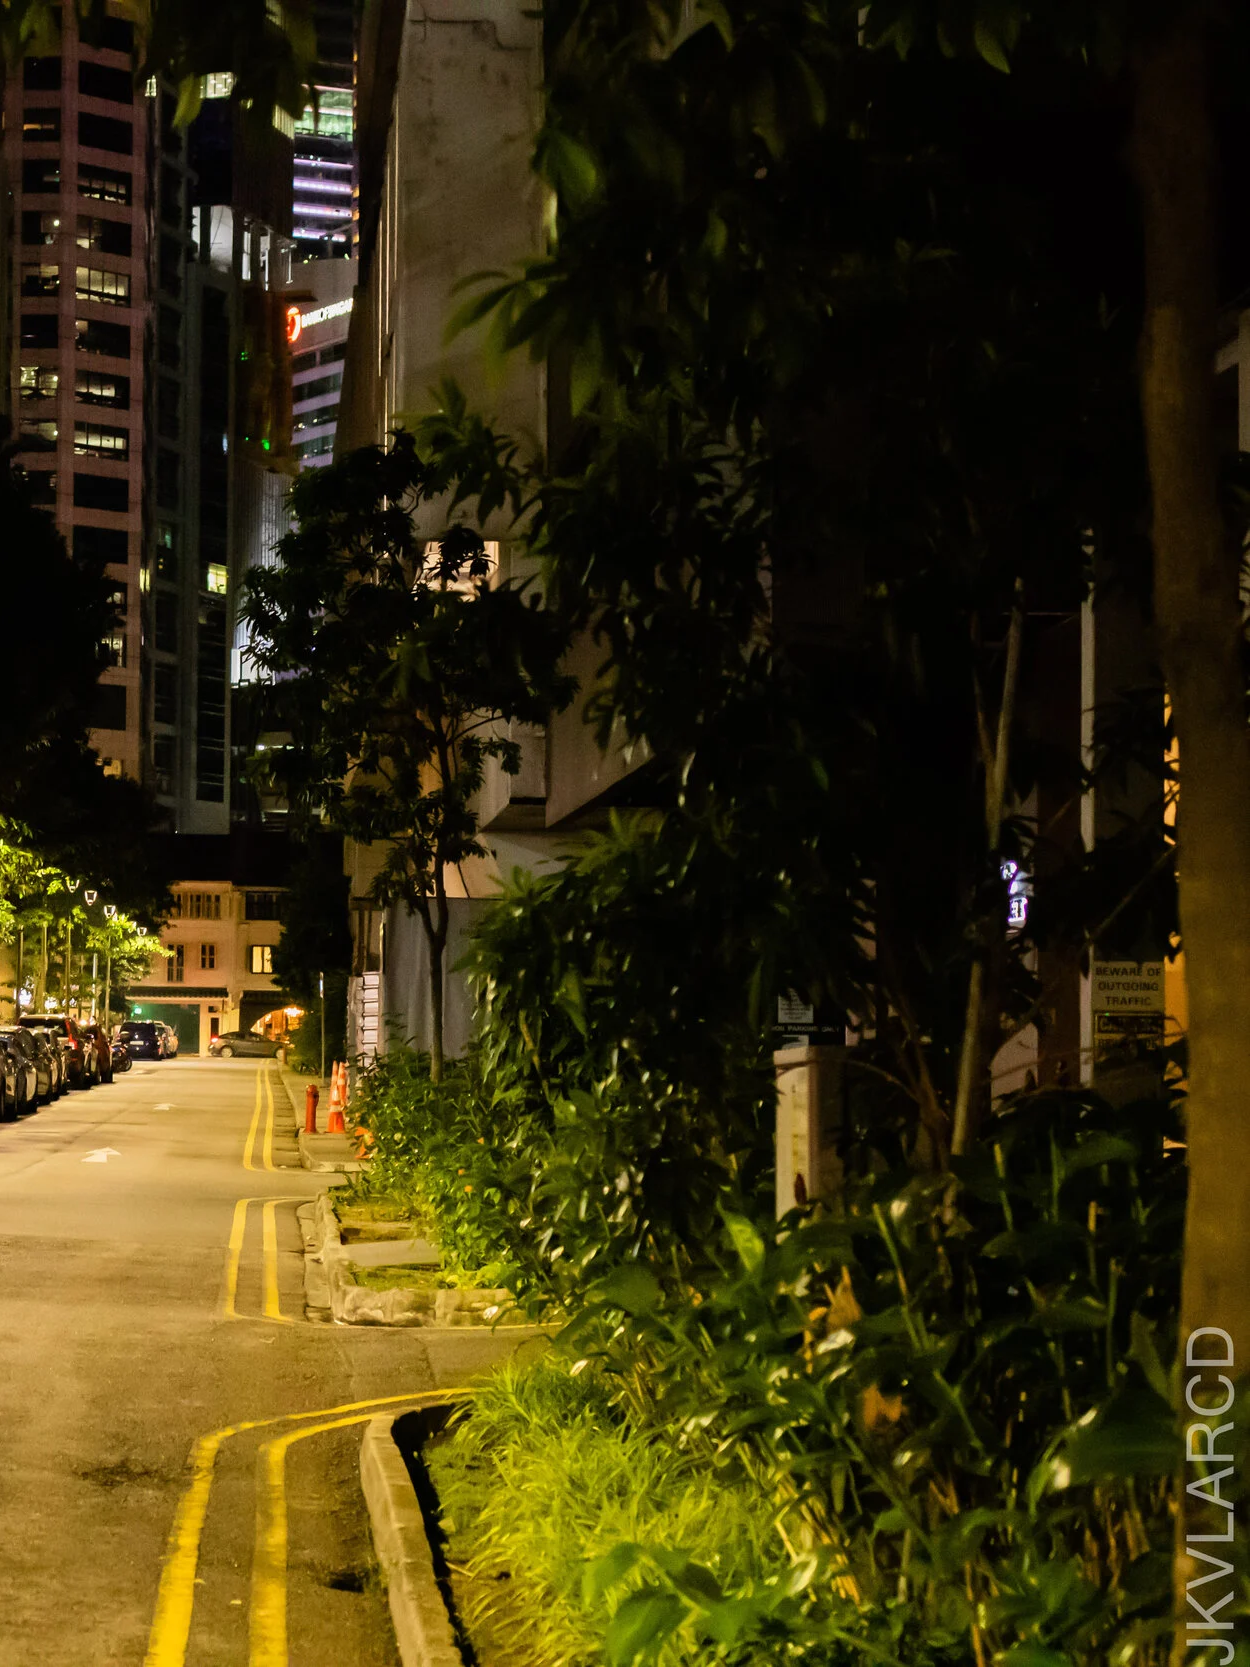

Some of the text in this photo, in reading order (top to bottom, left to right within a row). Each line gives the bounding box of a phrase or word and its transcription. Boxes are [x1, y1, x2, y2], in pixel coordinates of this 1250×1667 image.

[1095, 967, 1162, 977] BEWARE OF
[1098, 982, 1159, 991] OUTGOING
[1105, 996, 1152, 1005] TRAFFIC
